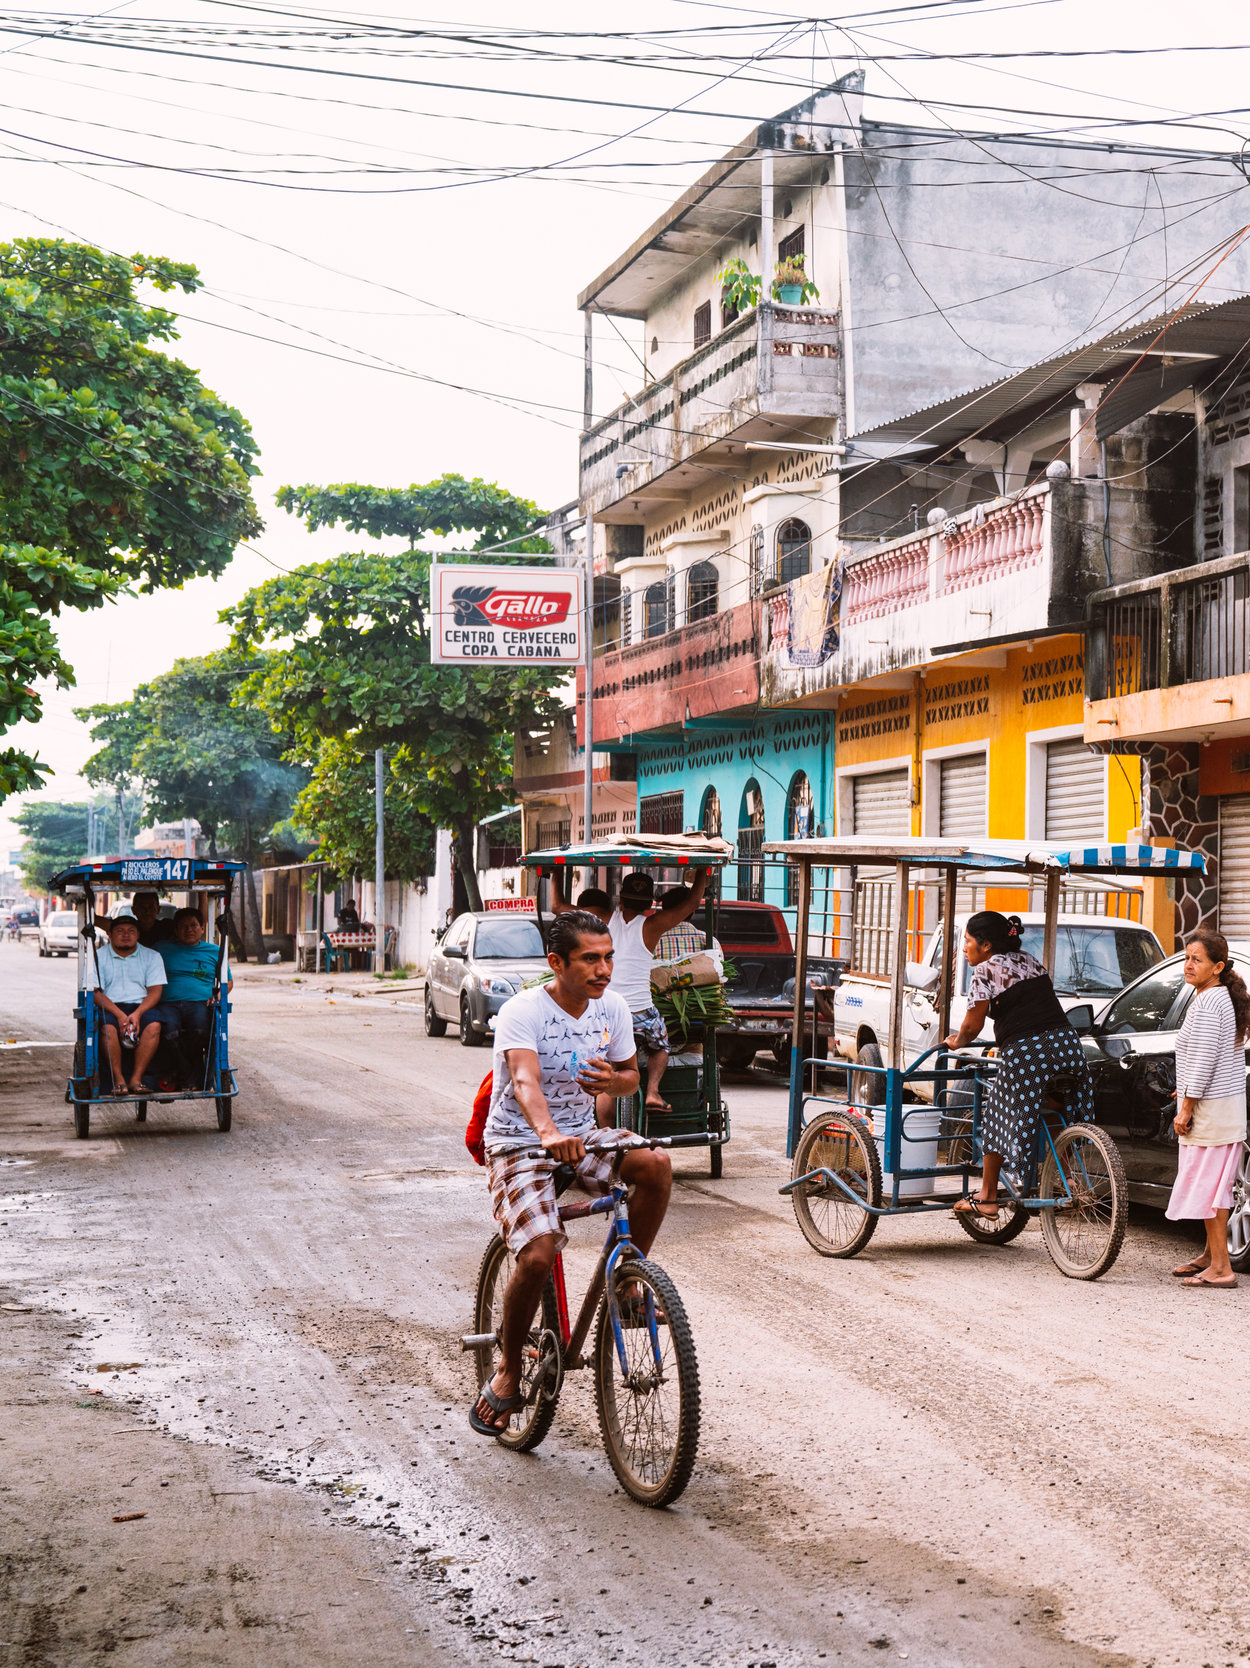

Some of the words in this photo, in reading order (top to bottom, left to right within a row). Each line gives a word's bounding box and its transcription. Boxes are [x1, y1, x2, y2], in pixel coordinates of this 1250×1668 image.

[485, 595, 559, 620] Gallo
[445, 630, 495, 643] CENTRO
[503, 632, 577, 645] CERVECERO
[462, 645, 498, 656] COPA
[507, 646, 561, 657] CABANA
[164, 860, 189, 880] 147
[490, 899, 534, 910] COMPRA
